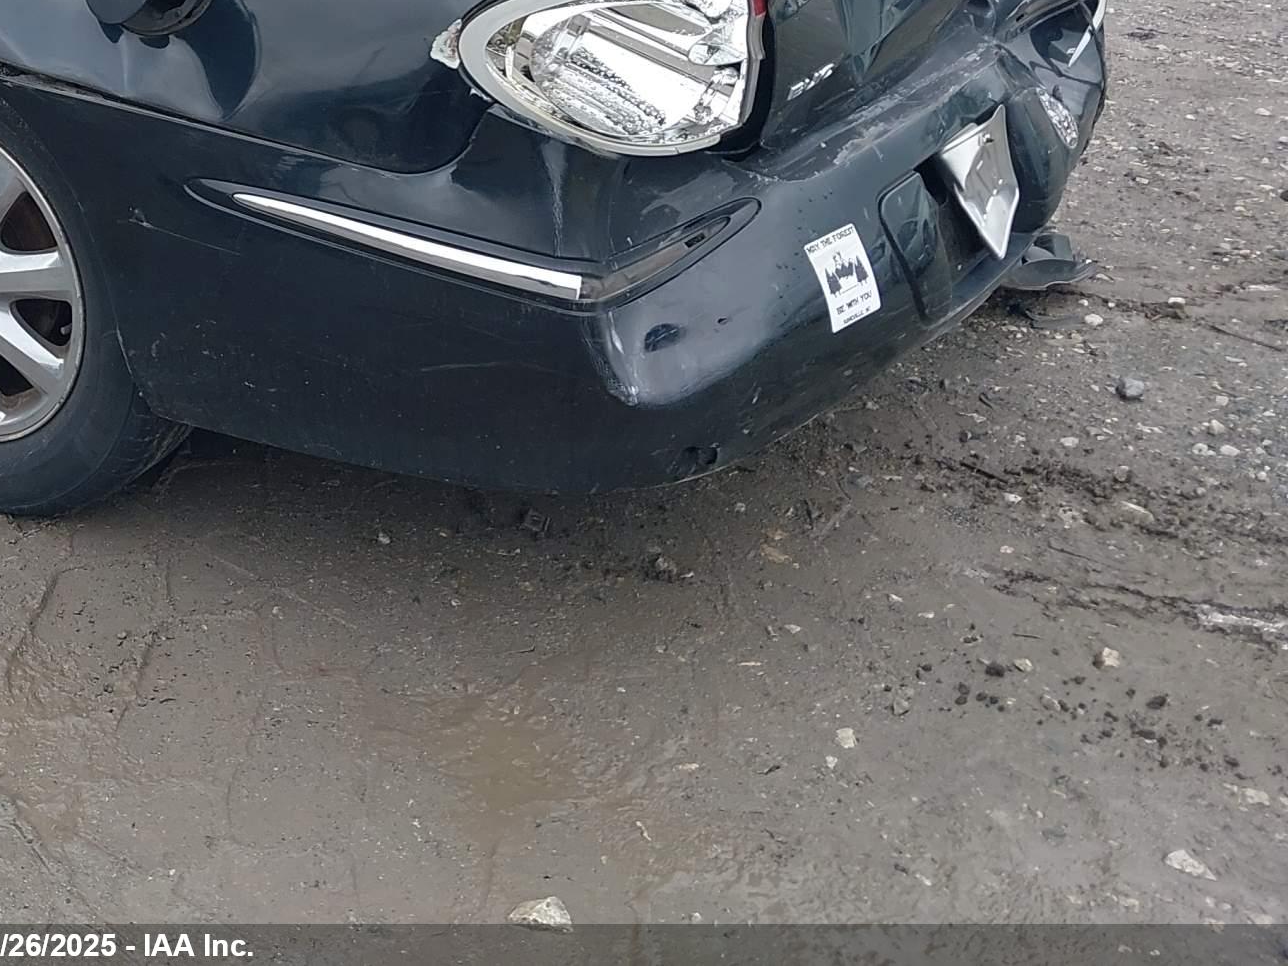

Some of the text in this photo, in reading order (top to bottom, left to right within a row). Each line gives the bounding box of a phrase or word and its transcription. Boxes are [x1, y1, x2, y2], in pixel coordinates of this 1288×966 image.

[820, 235, 833, 248] THE
[832, 226, 854, 242] FOREST
[836, 305, 846, 315] BE
[860, 290, 872, 302] YOU
